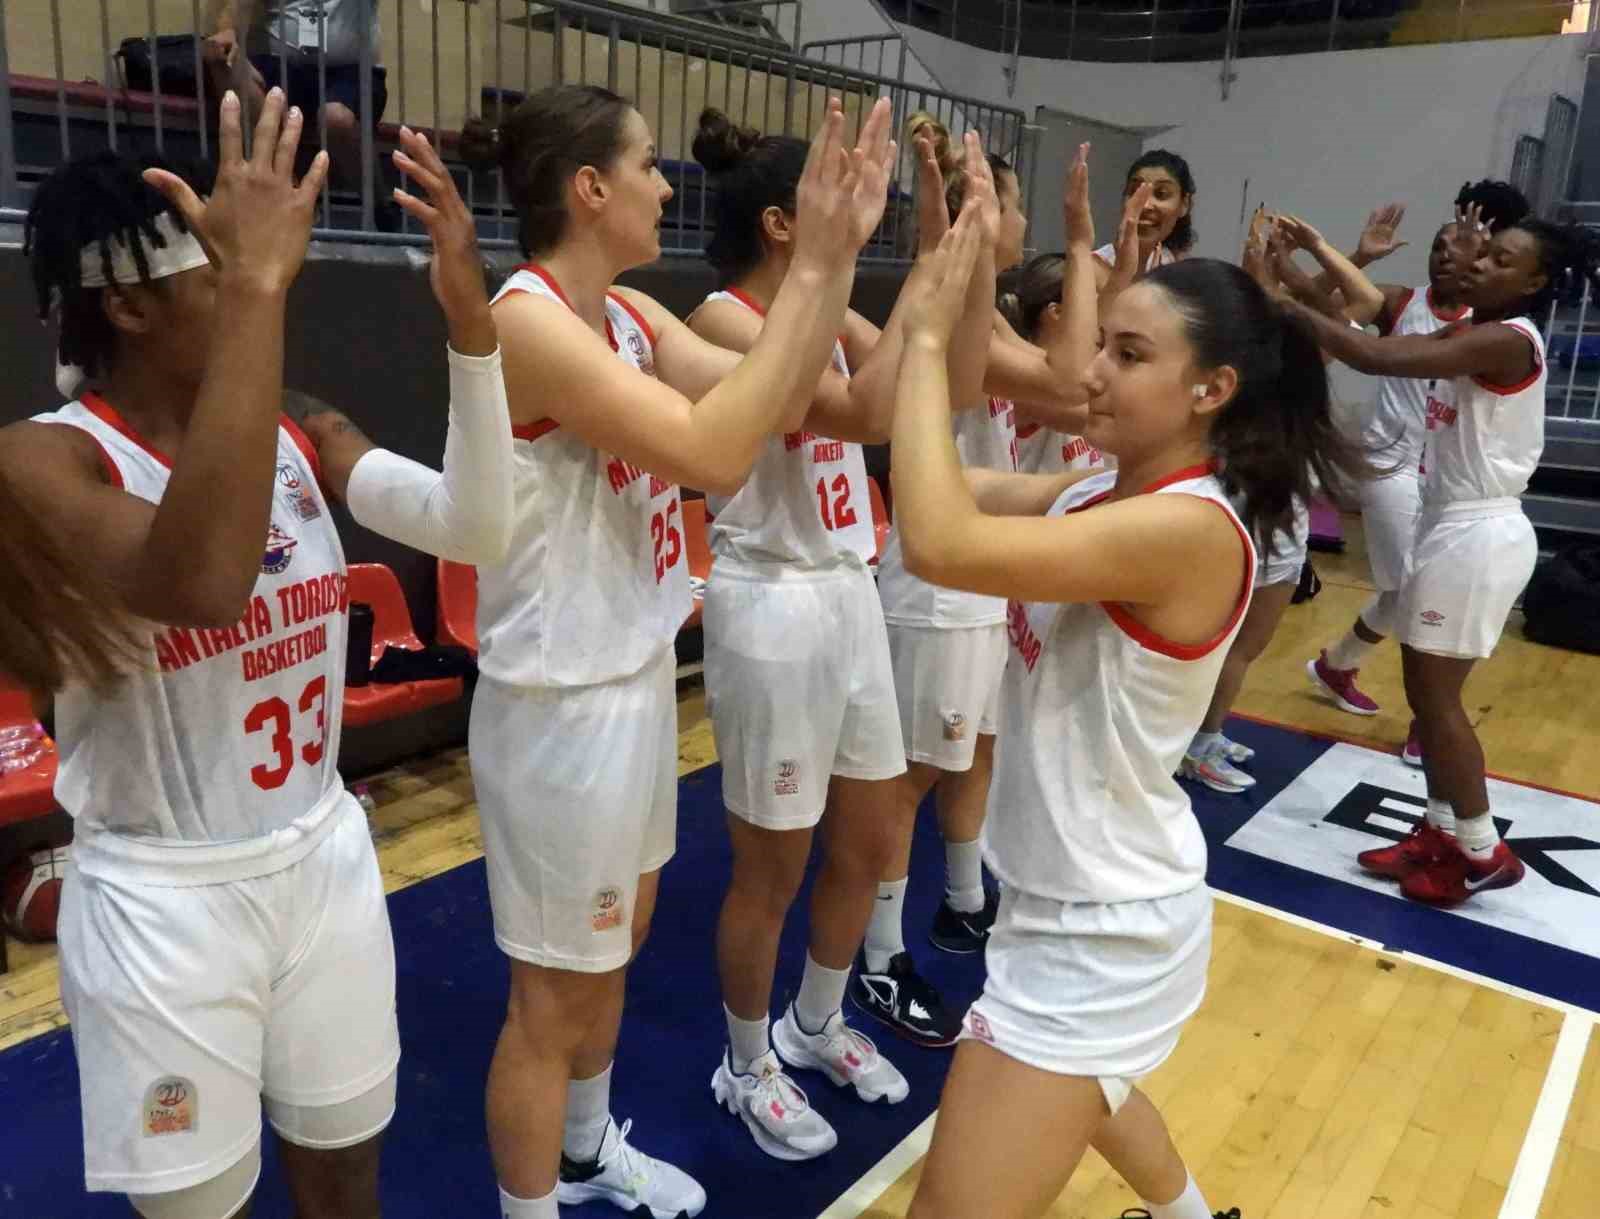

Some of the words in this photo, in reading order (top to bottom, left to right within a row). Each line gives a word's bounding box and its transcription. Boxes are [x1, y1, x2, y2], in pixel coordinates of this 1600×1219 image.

[651, 498, 681, 584] 25
[816, 472, 858, 532] 12
[244, 675, 326, 791] 33
